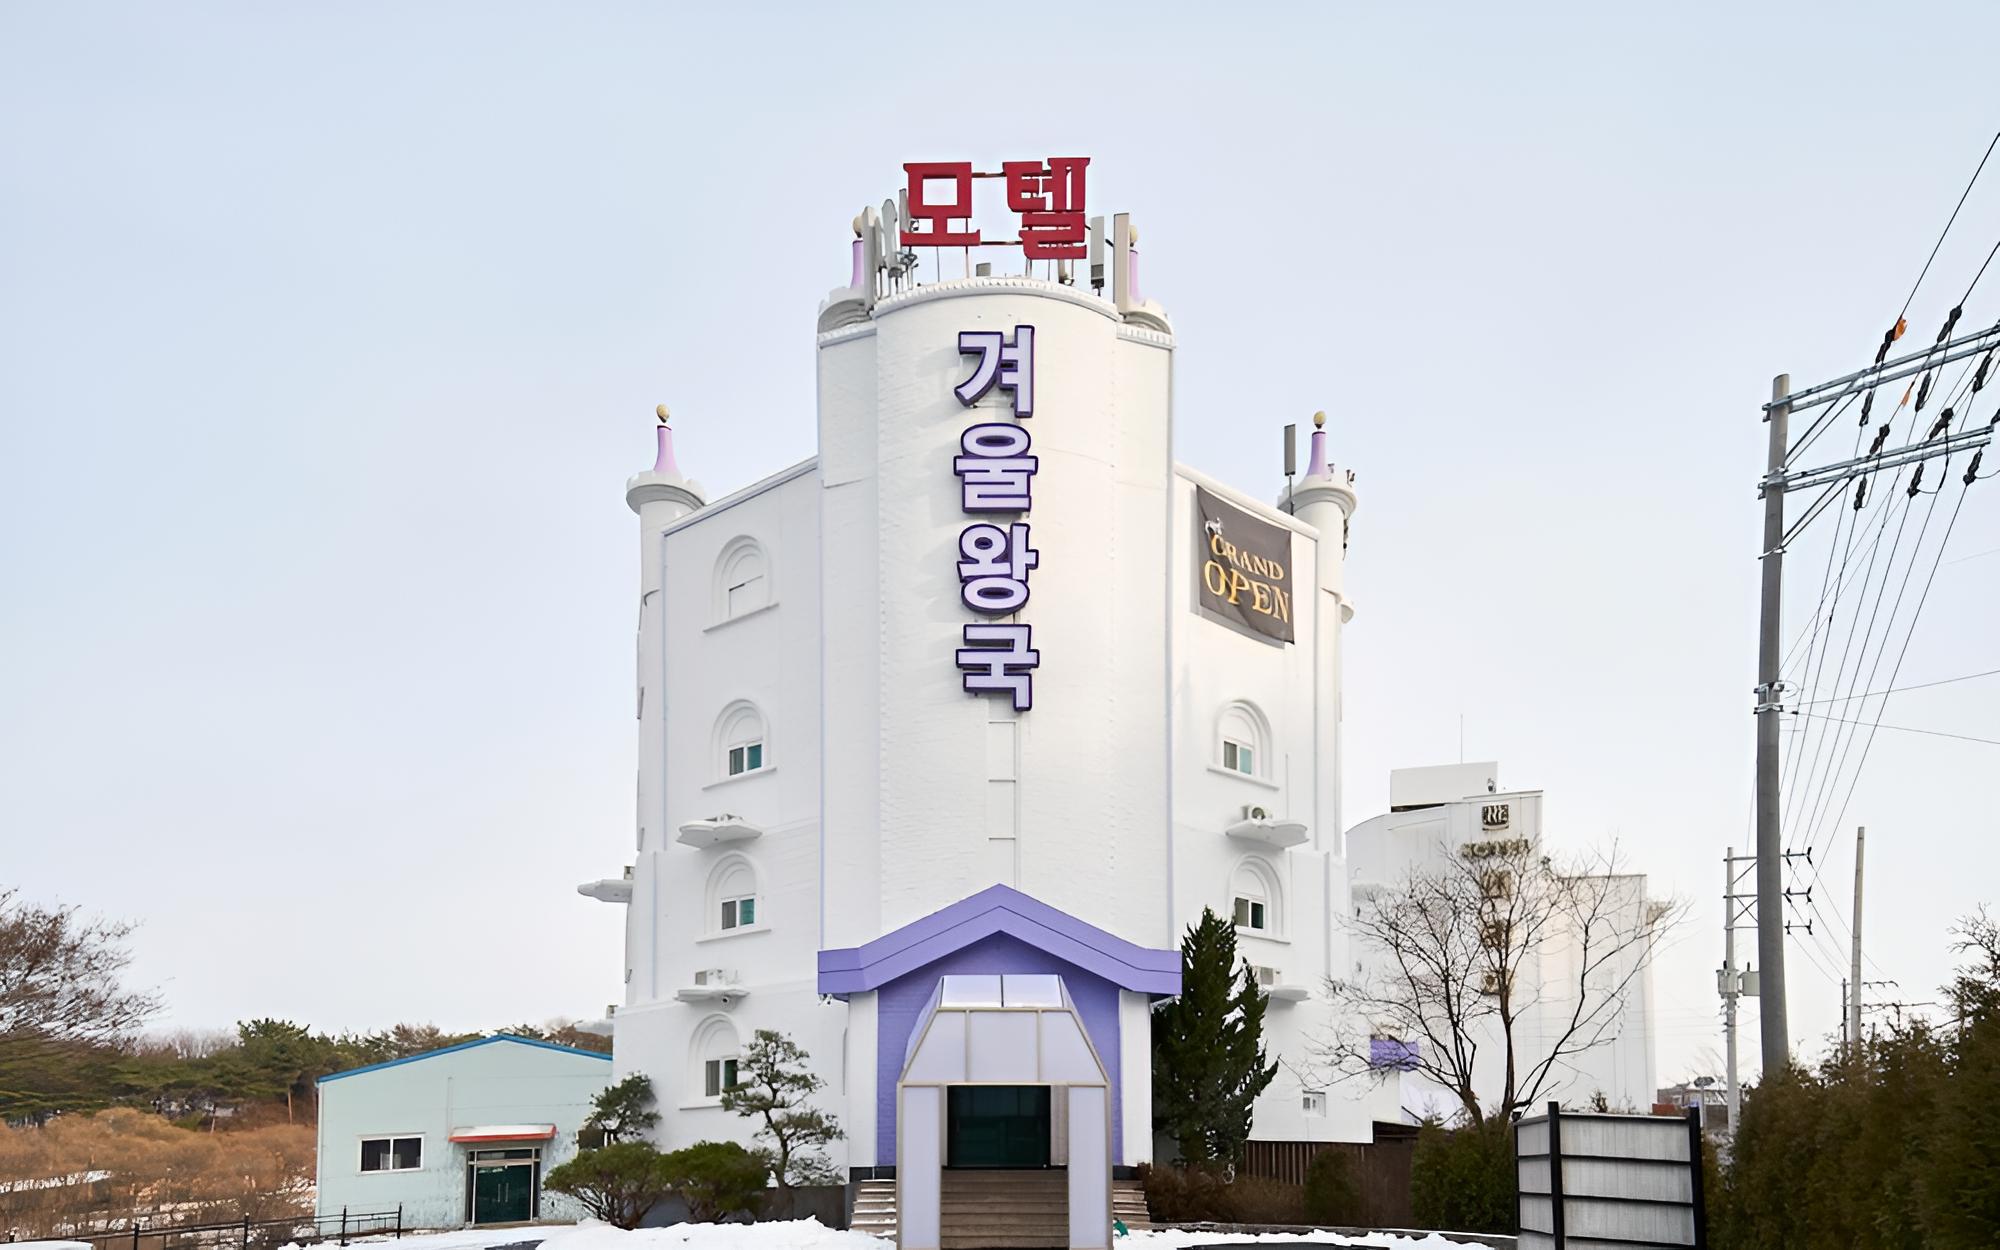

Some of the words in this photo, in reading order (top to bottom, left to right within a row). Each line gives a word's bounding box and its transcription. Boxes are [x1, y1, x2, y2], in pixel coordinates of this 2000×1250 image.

[900, 157, 1091, 259] 모텔
[954, 325, 1040, 711] 겨울왕국
[1211, 534, 1284, 580] GRAND
[1204, 560, 1288, 623] OPEN
